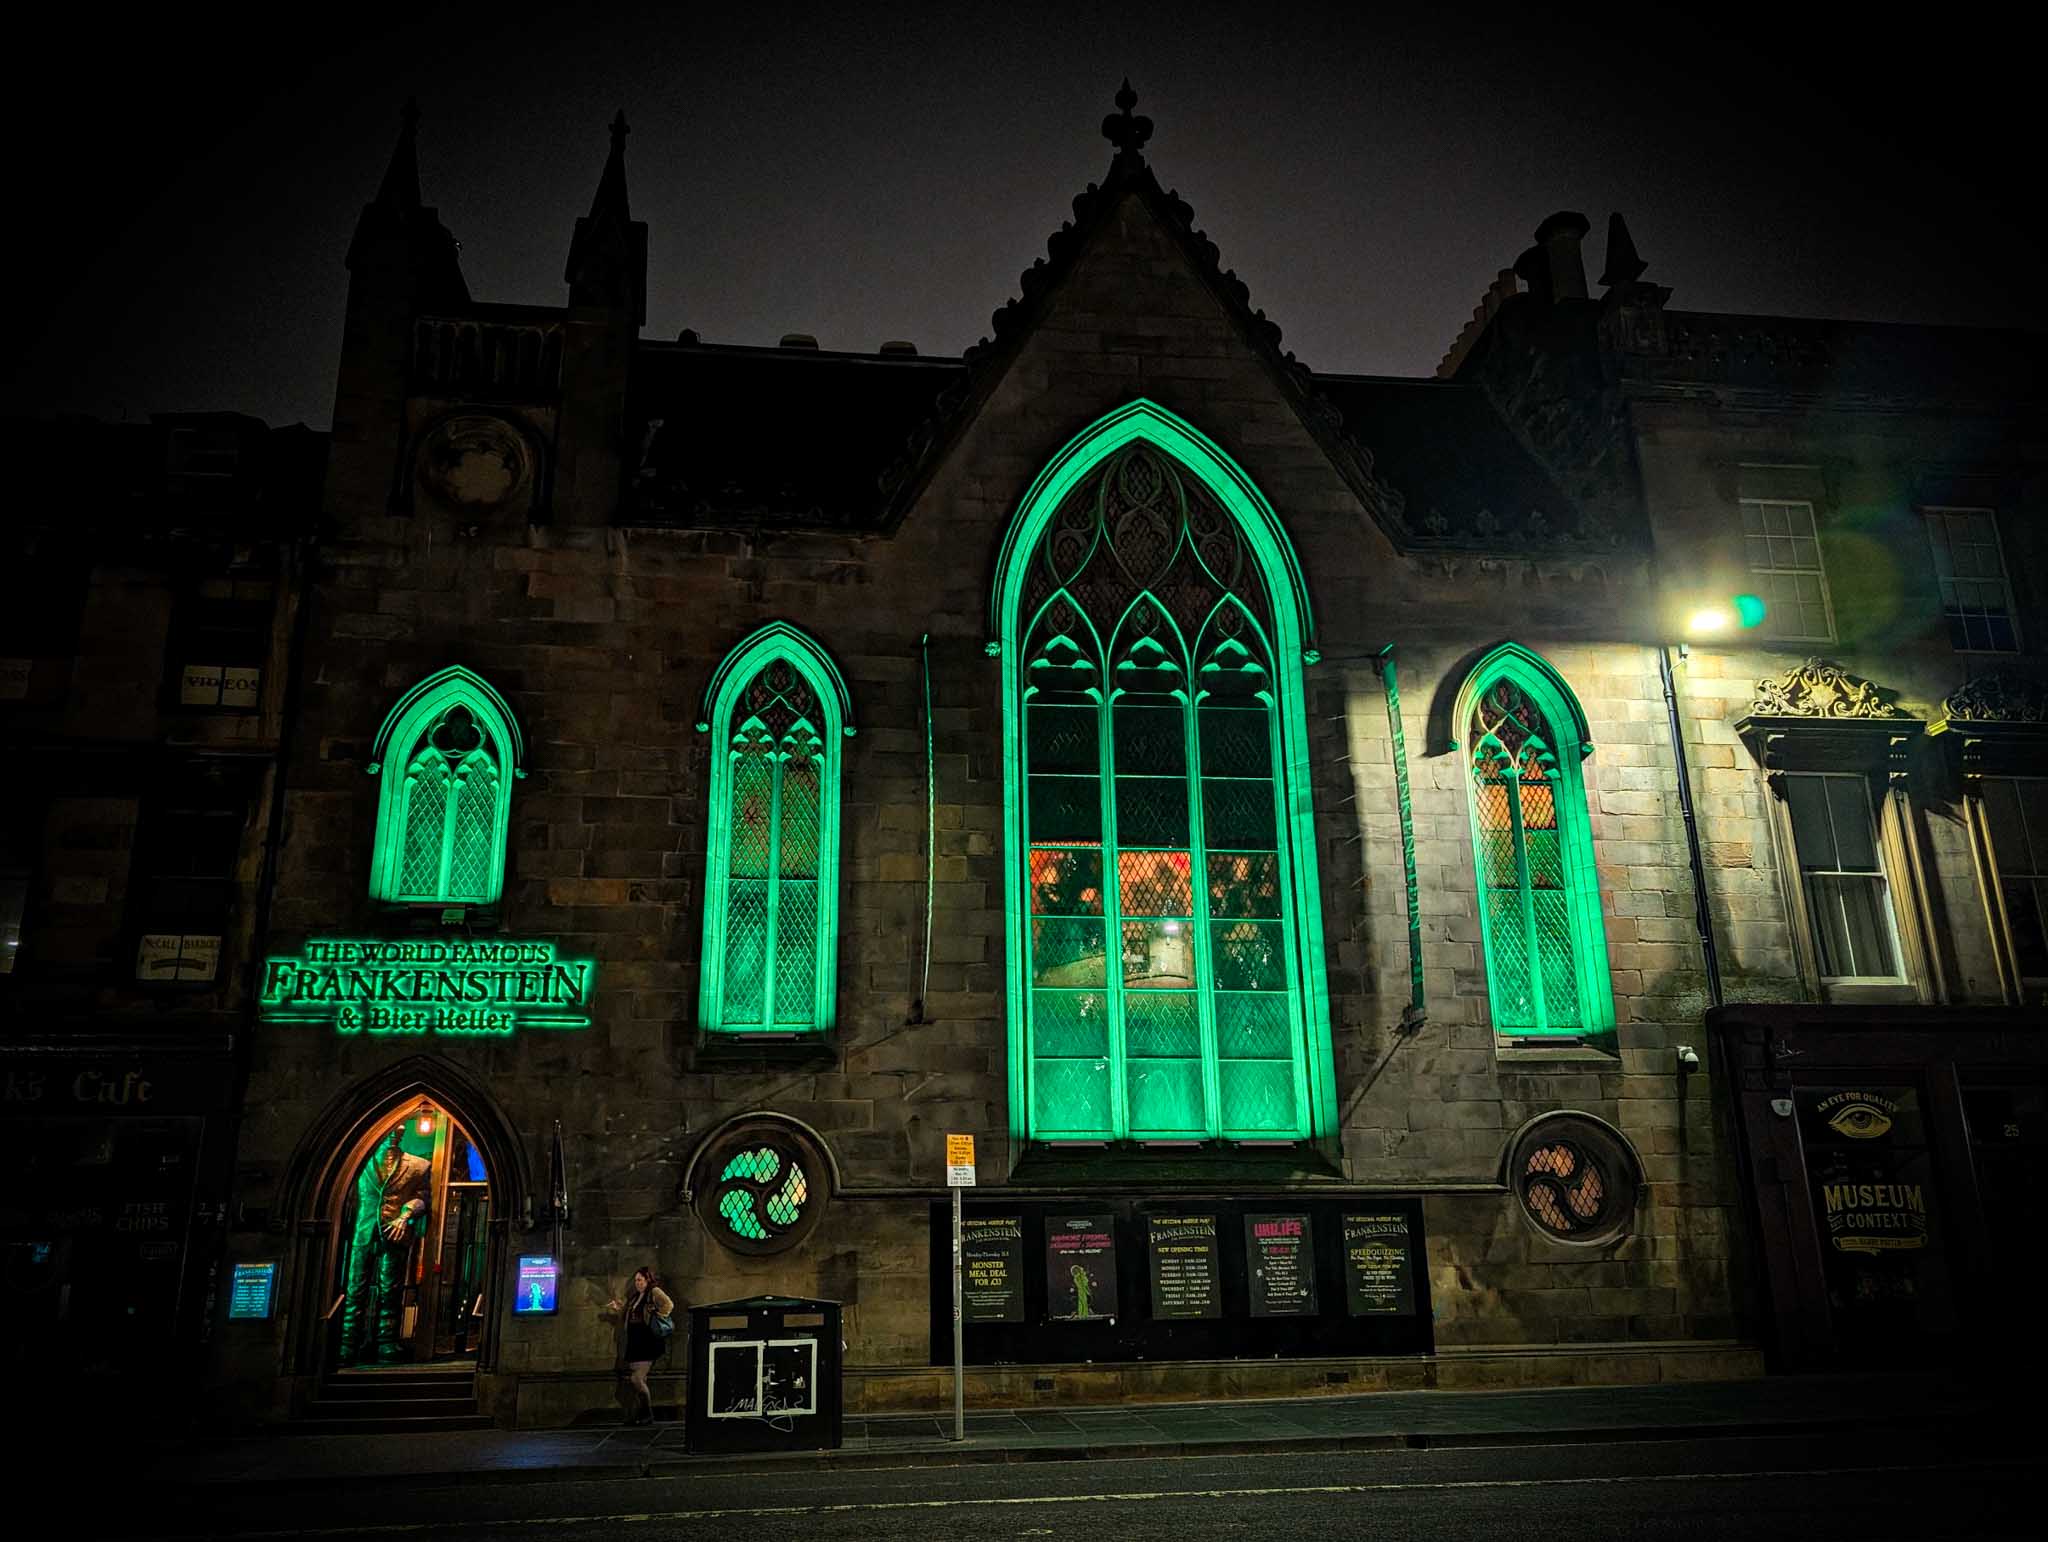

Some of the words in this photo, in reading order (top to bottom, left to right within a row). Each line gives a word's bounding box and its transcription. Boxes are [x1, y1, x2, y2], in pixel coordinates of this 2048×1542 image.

[189, 677, 257, 691] VIDEOS
[307, 942, 354, 963] THE
[359, 942, 447, 963] WORLD
[450, 942, 552, 964] FAMOUS
[262, 960, 588, 1006] FRANKENSTEIN
[337, 1007, 358, 1030] &
[369, 1006, 427, 1031] Bier
[437, 1007, 514, 1032] Keller
[1817, 1100, 1829, 1113] AN
[1827, 1093, 1846, 1107] EYE
[1845, 1091, 1861, 1102] FOR
[1862, 1092, 1898, 1113] QUALITY
[1823, 1184, 1927, 1214] MUSEUM
[1845, 1212, 1908, 1229] CONTEXT
[961, 1225, 1022, 1243] RANKENSTEIN
[1150, 1225, 1216, 1243] FRANKENSTEIN
[1344, 1223, 1409, 1240] FRANKENSTEIN
[1350, 1248, 1405, 1256] SPEEDQUIZZING
[971, 1260, 1005, 1269] MONSTER
[968, 1269, 988, 1278] MEAL
[989, 1269, 1008, 1278] DEAL
[974, 1278, 989, 1287] FOR
